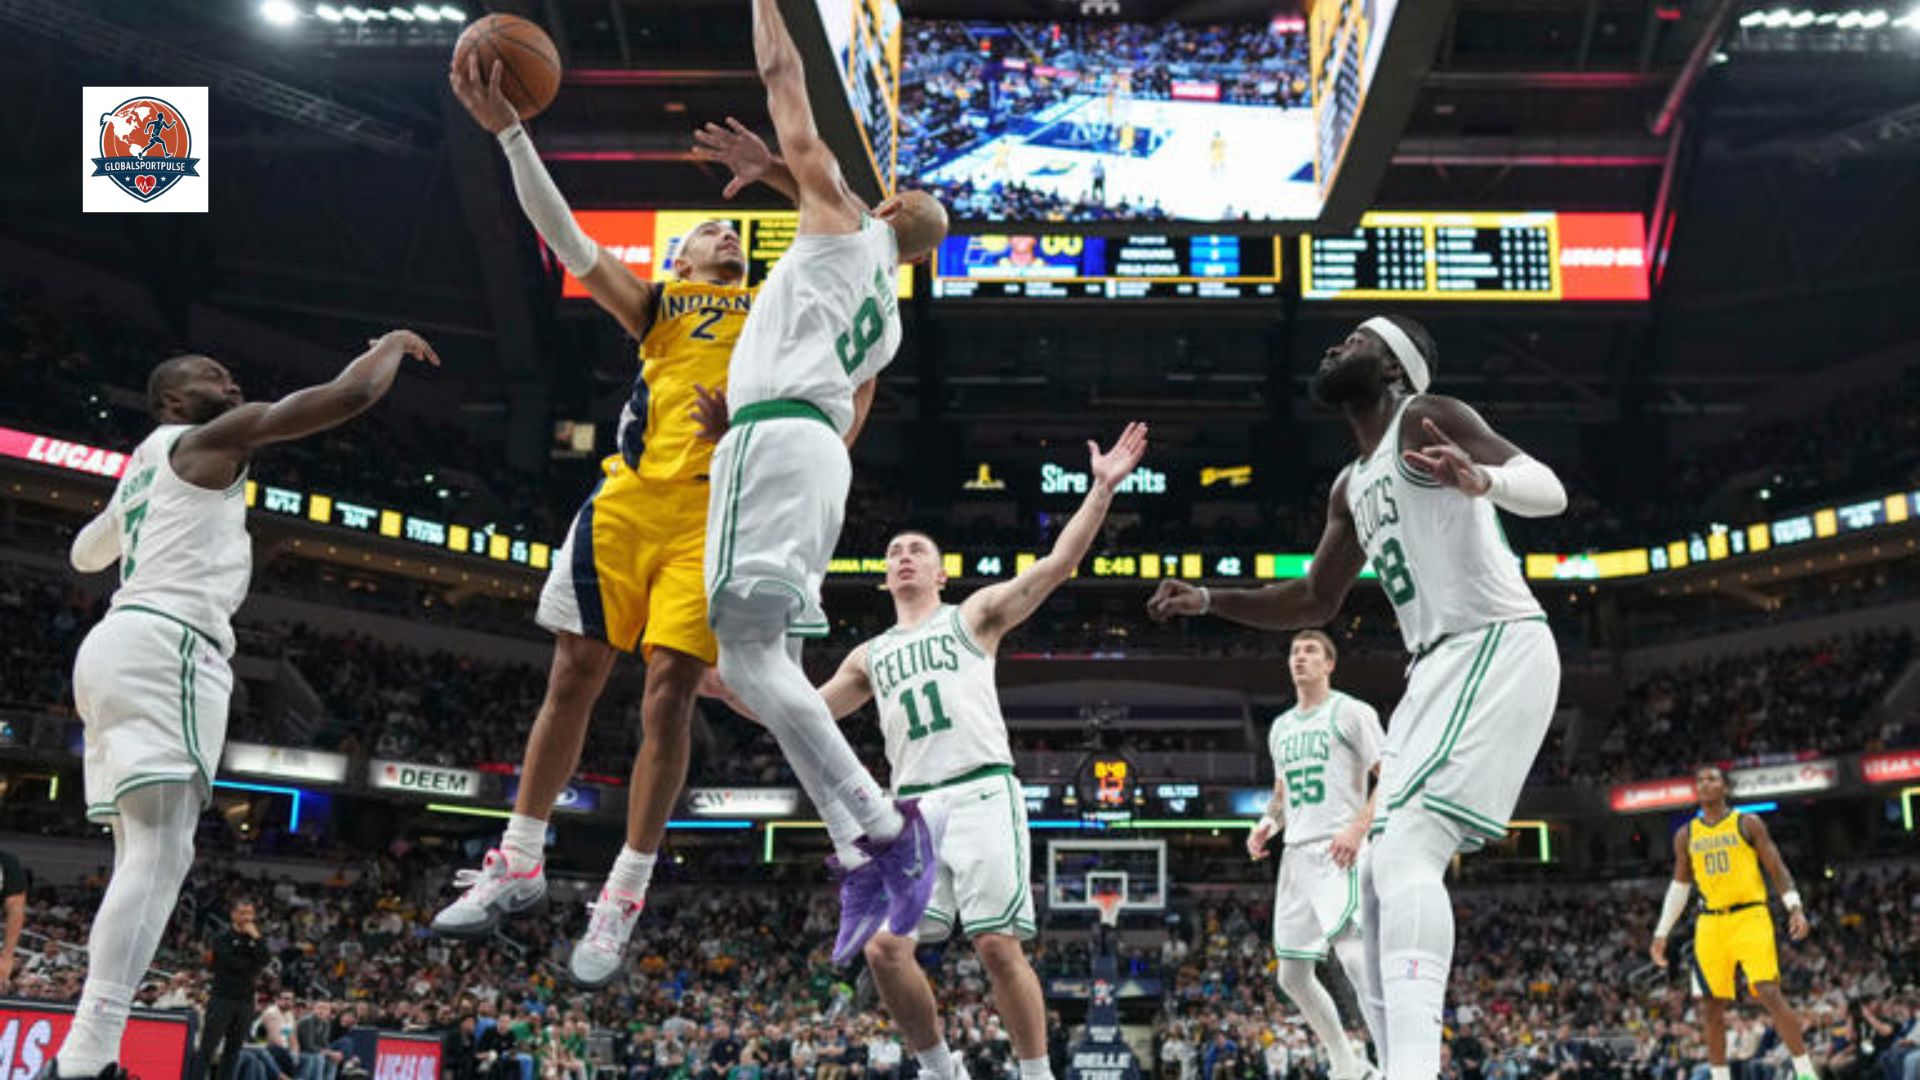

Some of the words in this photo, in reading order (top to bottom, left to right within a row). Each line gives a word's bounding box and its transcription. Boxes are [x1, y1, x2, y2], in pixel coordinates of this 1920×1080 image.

[690, 306, 724, 340] 2
[26, 436, 125, 478] LUCAS
[1041, 463, 1088, 494] Sire
[976, 557, 1002, 576] 44
[1216, 557, 1241, 576] 42
[874, 634, 958, 699] CELTICS
[899, 679, 953, 741] 11
[399, 768, 468, 791] DEEM
[1284, 764, 1325, 808] 55
[1692, 835, 1738, 852] INDIANA
[1704, 851, 1730, 875] 00
